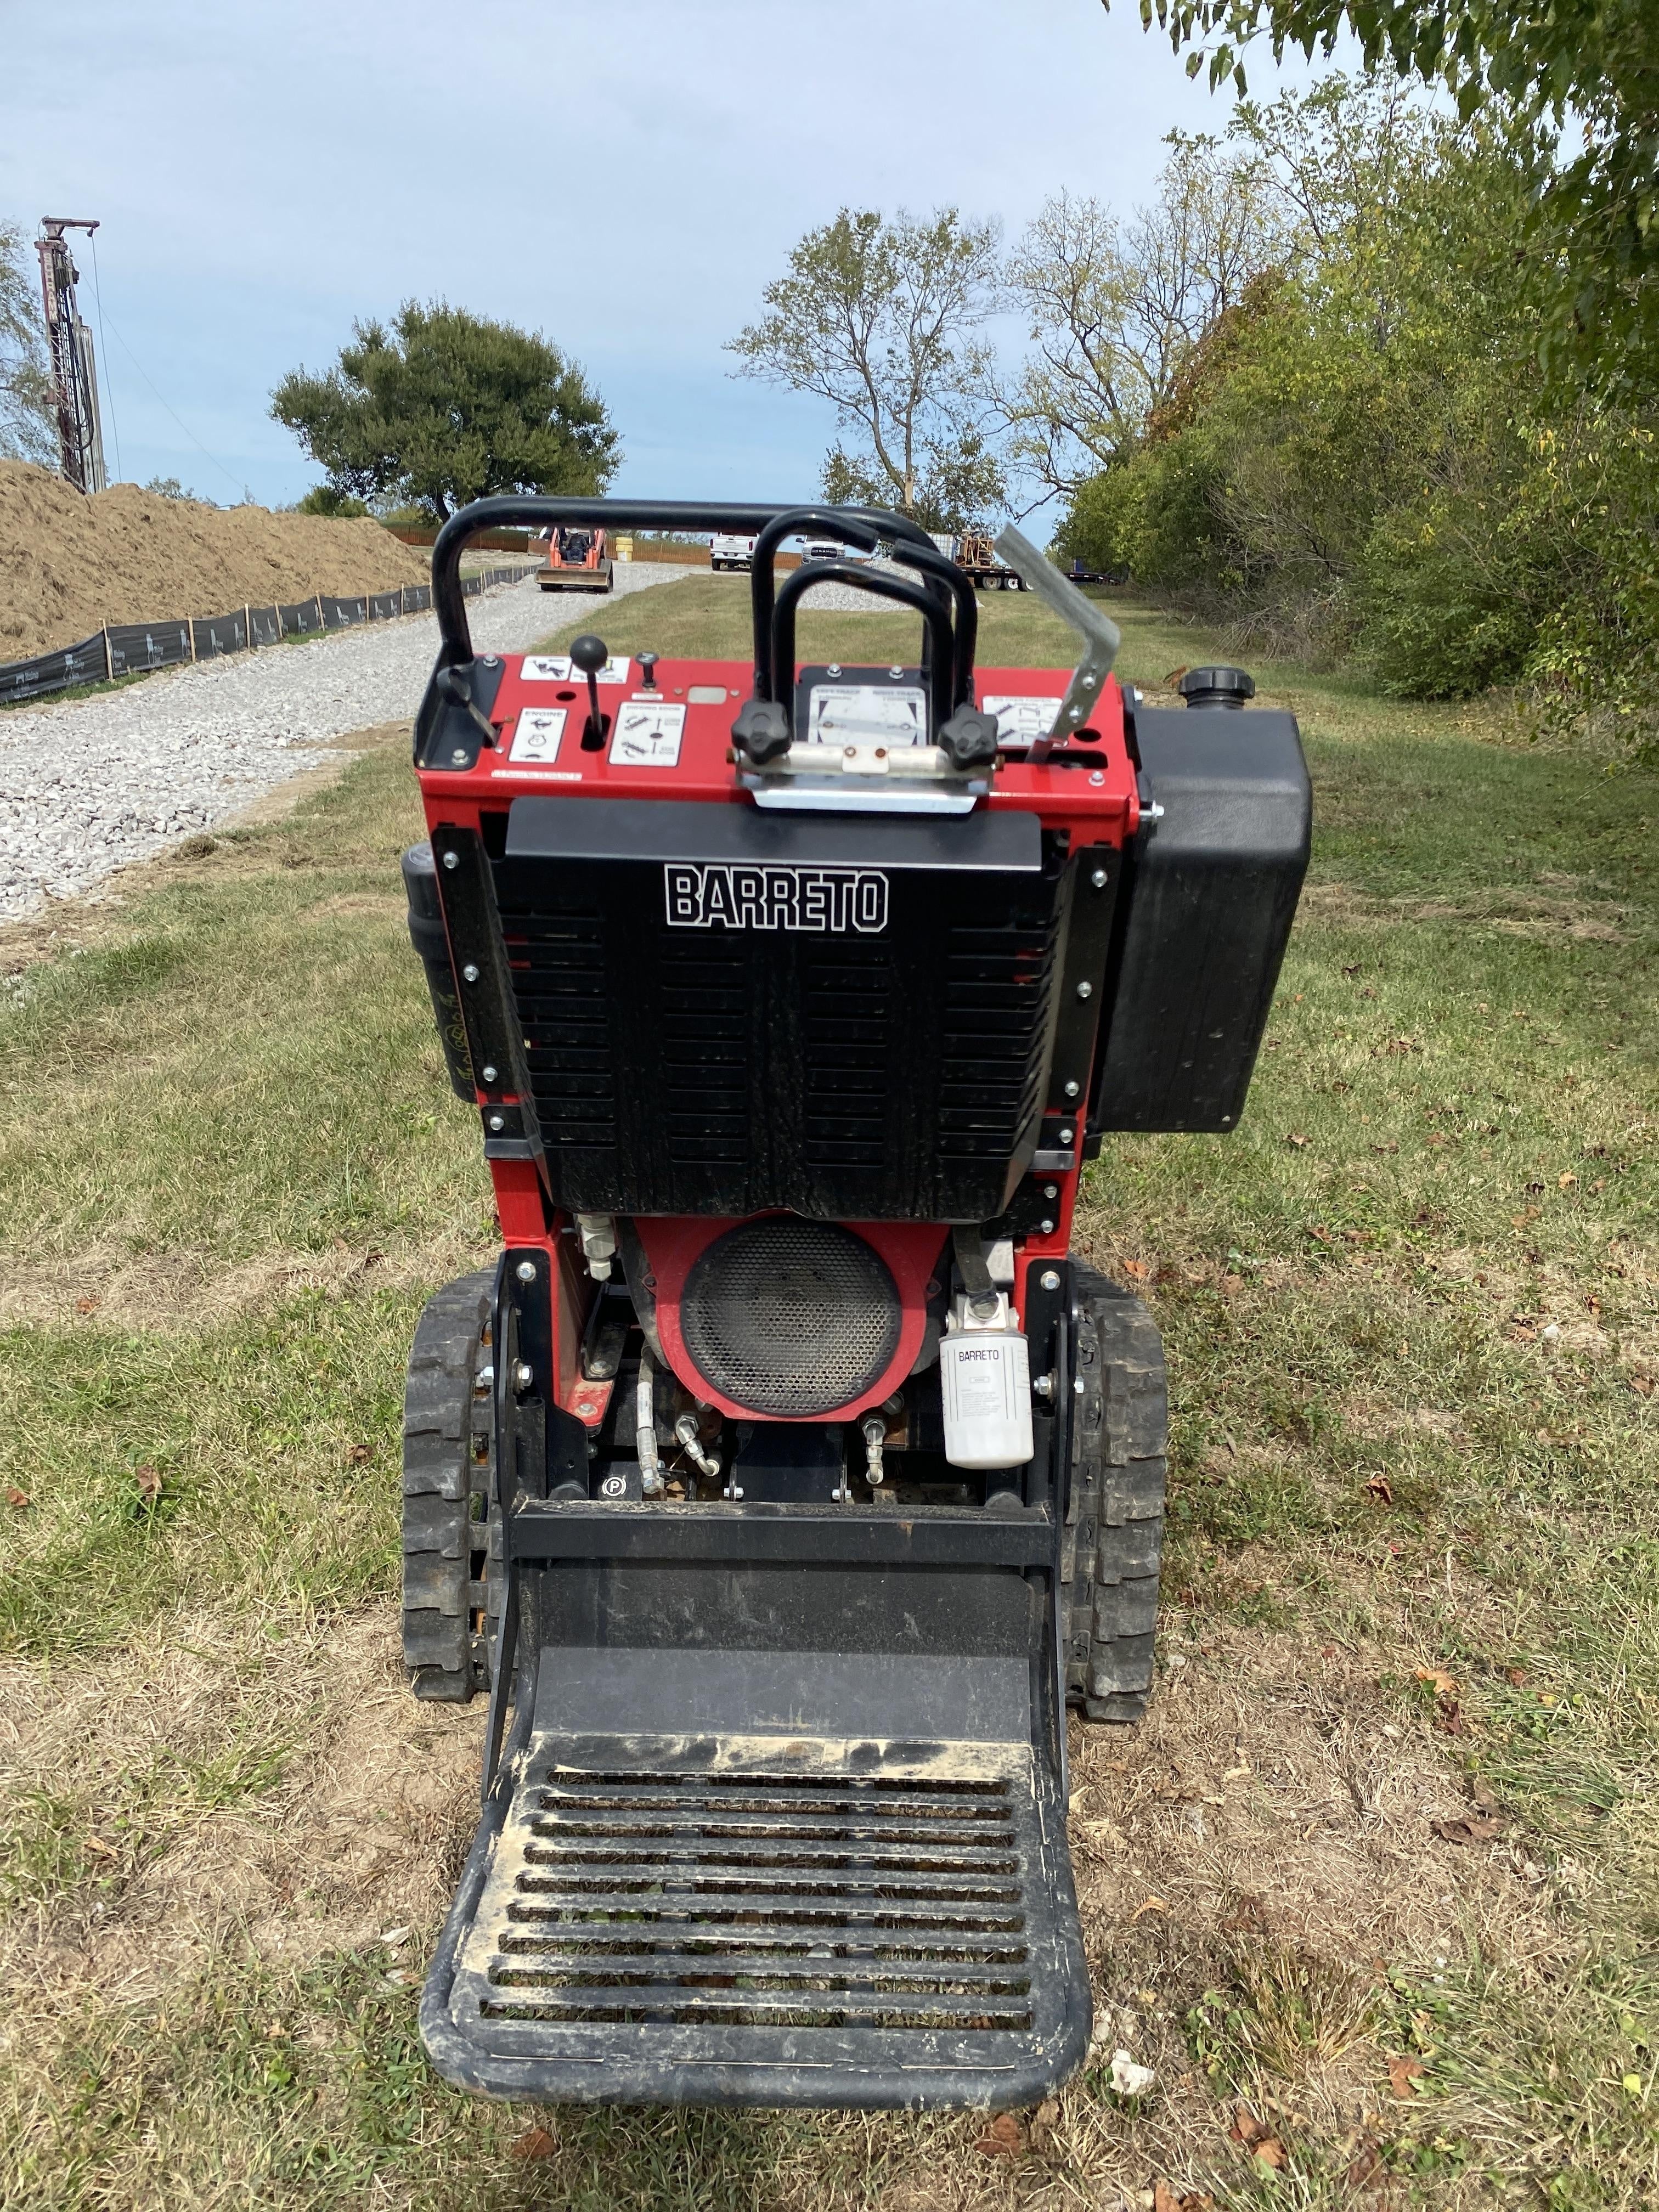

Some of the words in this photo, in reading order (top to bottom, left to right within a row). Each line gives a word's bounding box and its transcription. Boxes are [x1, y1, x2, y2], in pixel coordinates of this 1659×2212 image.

[664, 863, 889, 932] BARRETO
[959, 1350, 999, 1362] BARRETO
[610, 1481, 620, 1492] P
